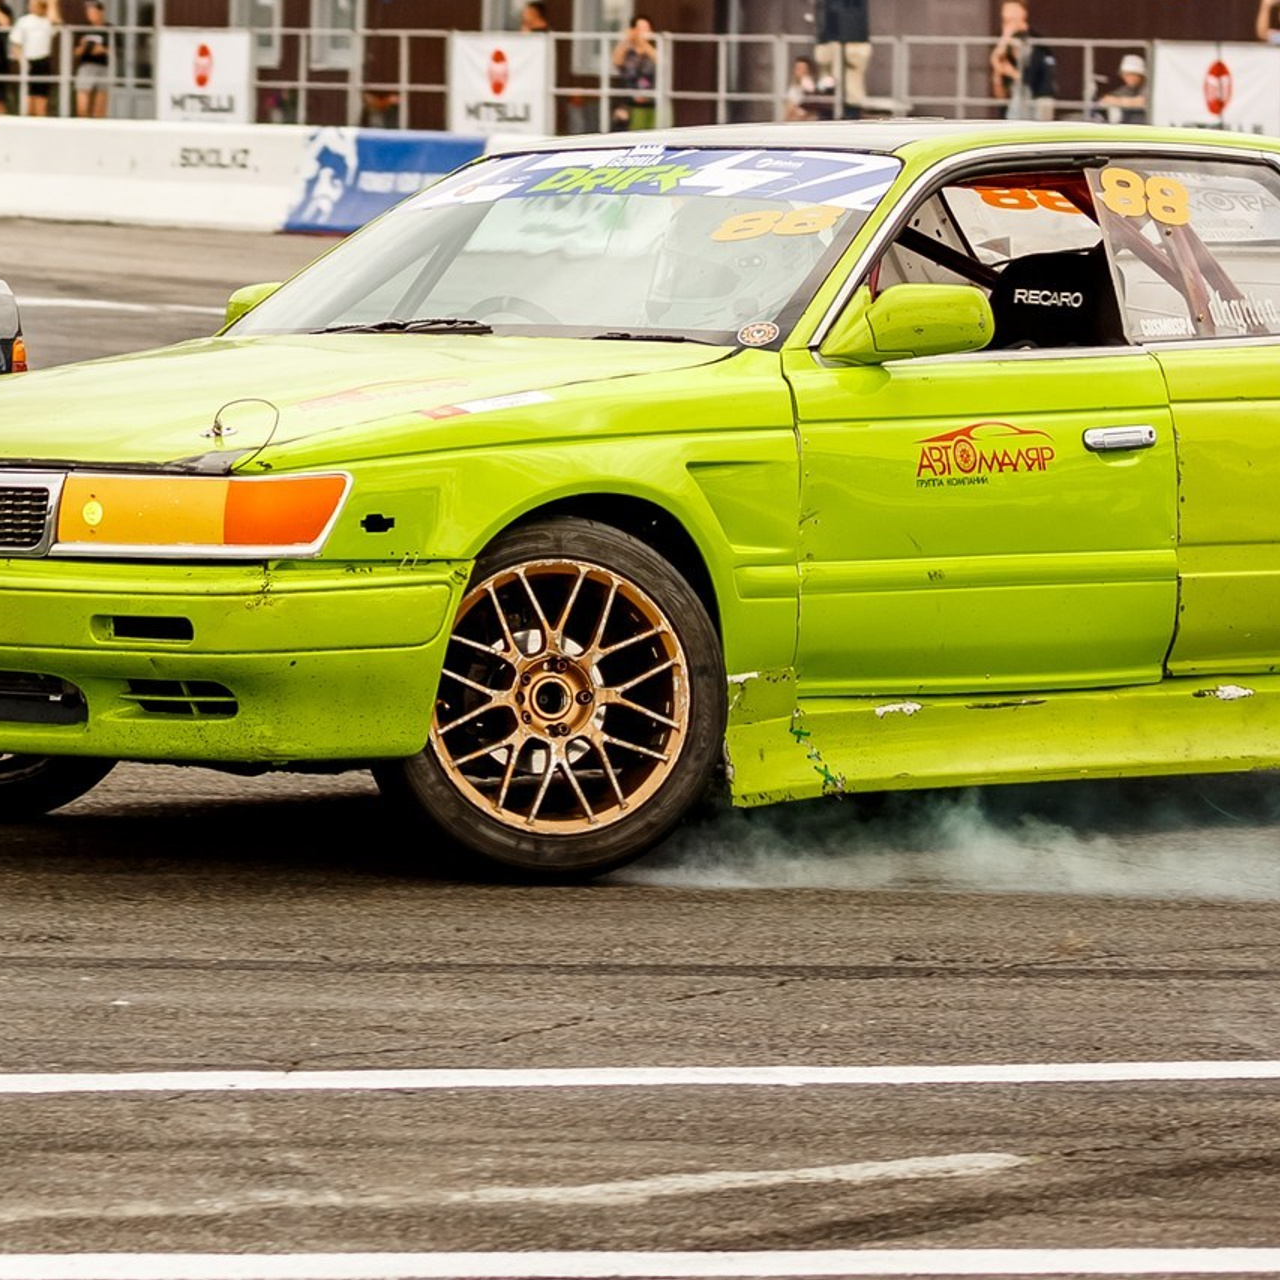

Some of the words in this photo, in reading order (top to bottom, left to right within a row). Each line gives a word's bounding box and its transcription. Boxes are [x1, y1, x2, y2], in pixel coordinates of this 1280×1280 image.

[526, 164, 703, 194] DRIFT
[1100, 167, 1190, 226] 88
[710, 204, 846, 242] 88
[1013, 288, 1083, 308] RECARO
[917, 438, 1055, 477] АВТОМАЛЯР
